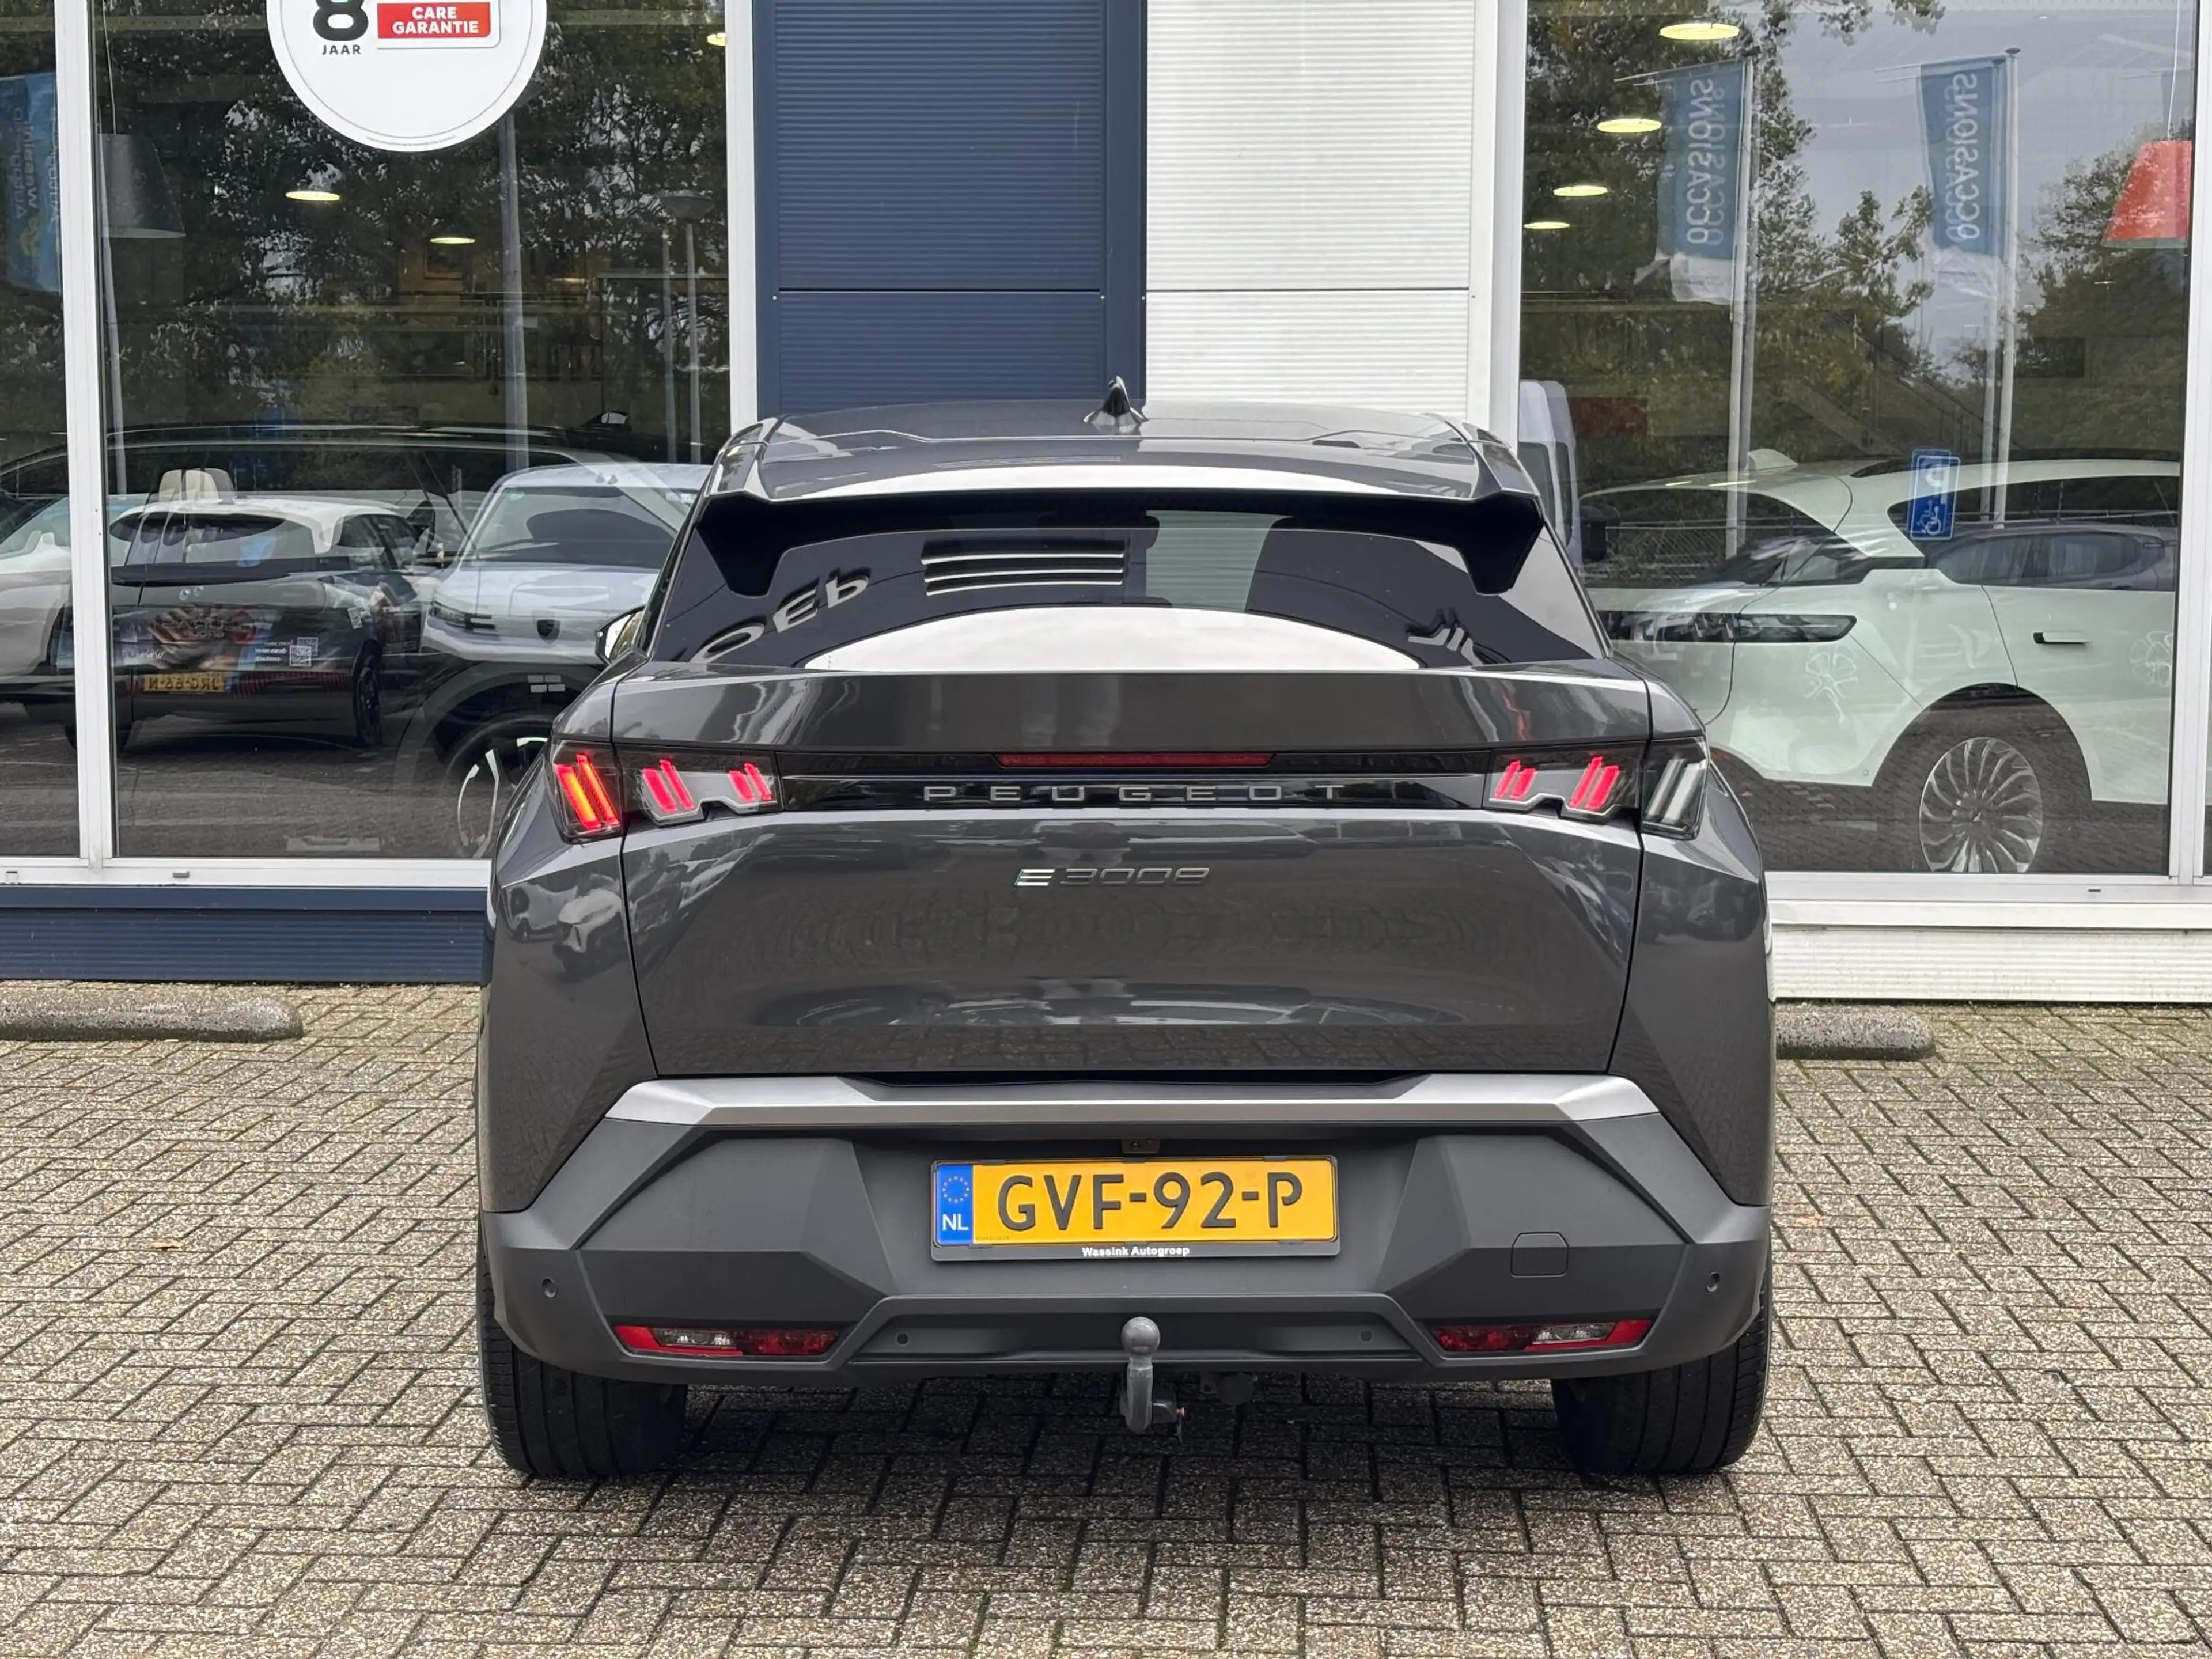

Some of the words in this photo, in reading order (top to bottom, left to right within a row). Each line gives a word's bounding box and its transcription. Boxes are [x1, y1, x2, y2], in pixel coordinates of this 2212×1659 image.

[412, 6, 457, 19] CARE
[392, 21, 479, 35] GARANTIE
[321, 44, 362, 55] JAAR
[923, 785, 1345, 801] PEUGEOT
[997, 1171, 1304, 1232] GVF-92-P
[942, 1214, 969, 1232] NL
[1081, 1247, 1129, 1256] Wassink
[1131, 1246, 1191, 1257] Autogroep
